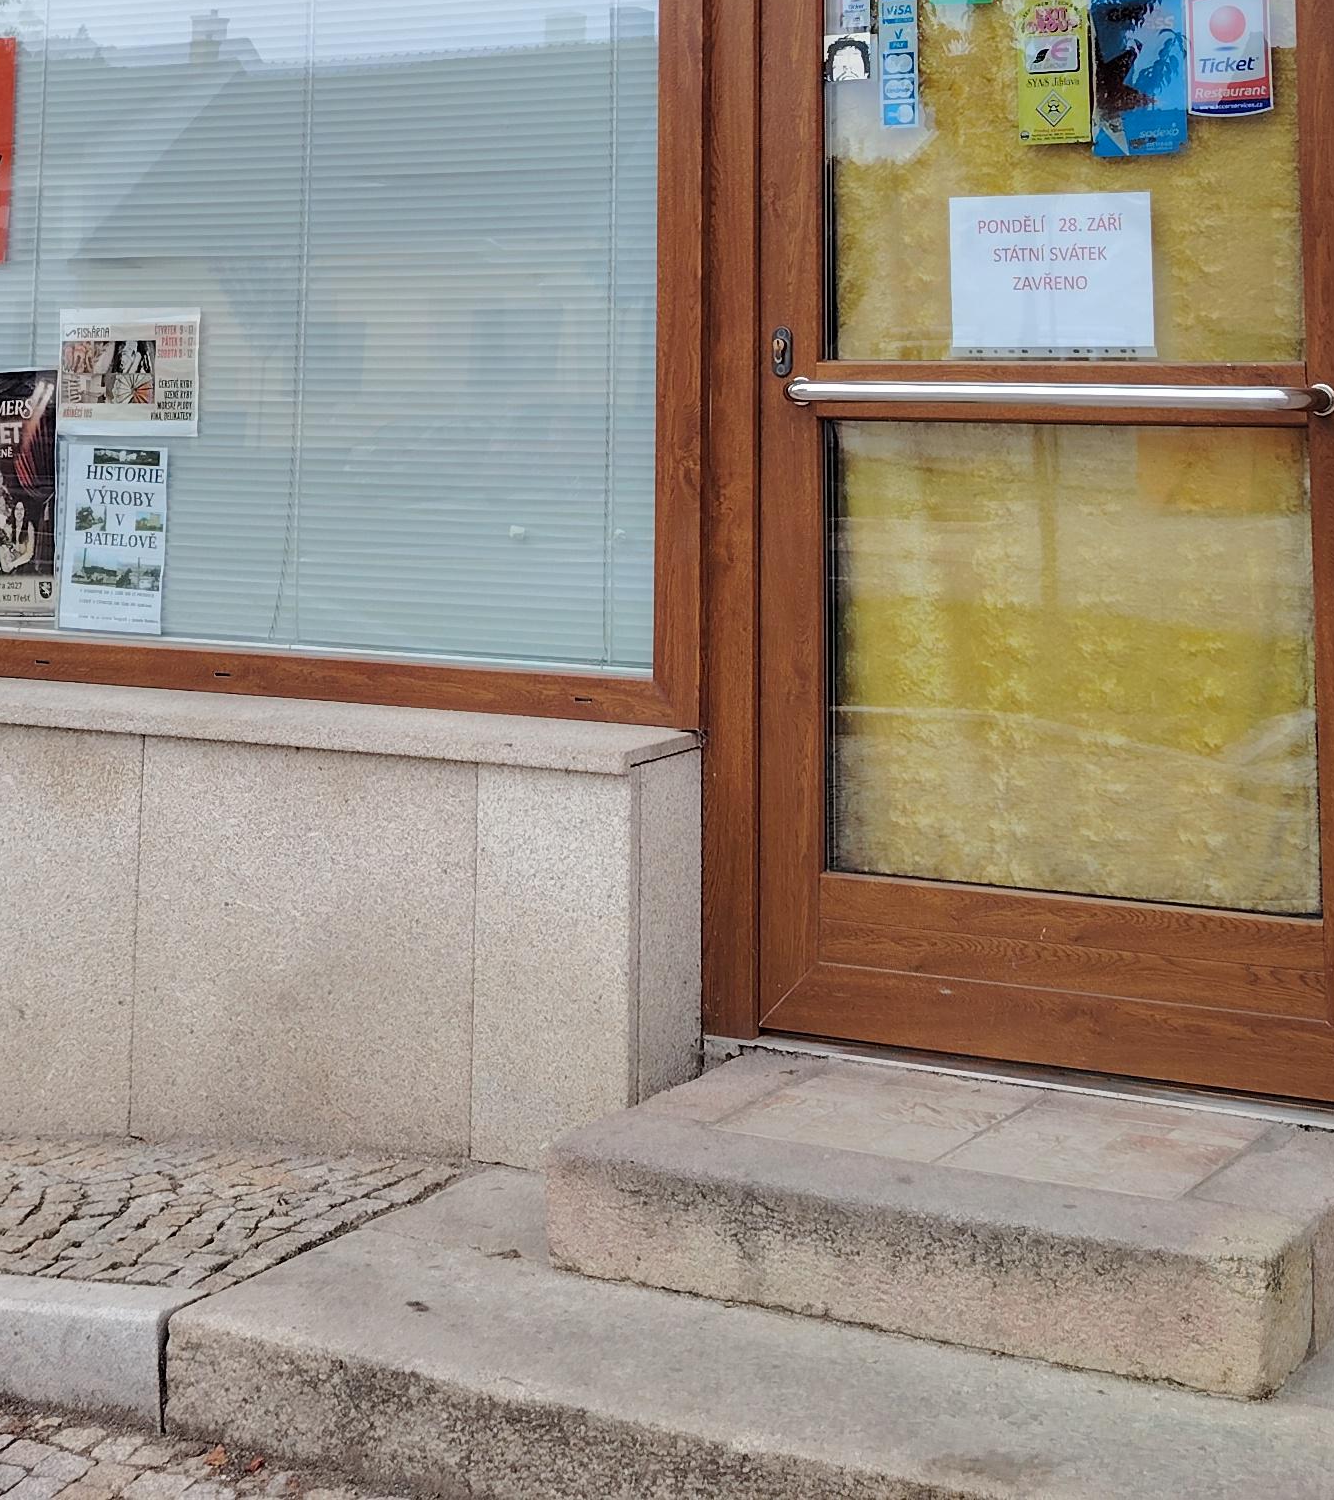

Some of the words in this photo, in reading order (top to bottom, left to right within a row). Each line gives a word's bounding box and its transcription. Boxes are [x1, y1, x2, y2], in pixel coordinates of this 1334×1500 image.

[887, 4, 913, 16] VISA
[1198, 57, 1256, 74] Ticket
[1194, 84, 1267, 99] Restaurant
[1139, 122, 1180, 138] sodexo
[977, 214, 1046, 235] PONDĚLÍ
[1058, 217, 1083, 233] 28.
[1086, 212, 1124, 232] ZÁŘÍ
[993, 244, 1046, 263] STÁTNÍ
[1049, 243, 1108, 262] SVÁTEK
[1012, 271, 1089, 291] ZAVŘENO
[86, 464, 165, 485] HISTORIE
[85, 486, 155, 508] VÝROBY
[115, 513, 126, 527] V
[83, 532, 158, 549] BATELOVĚ
